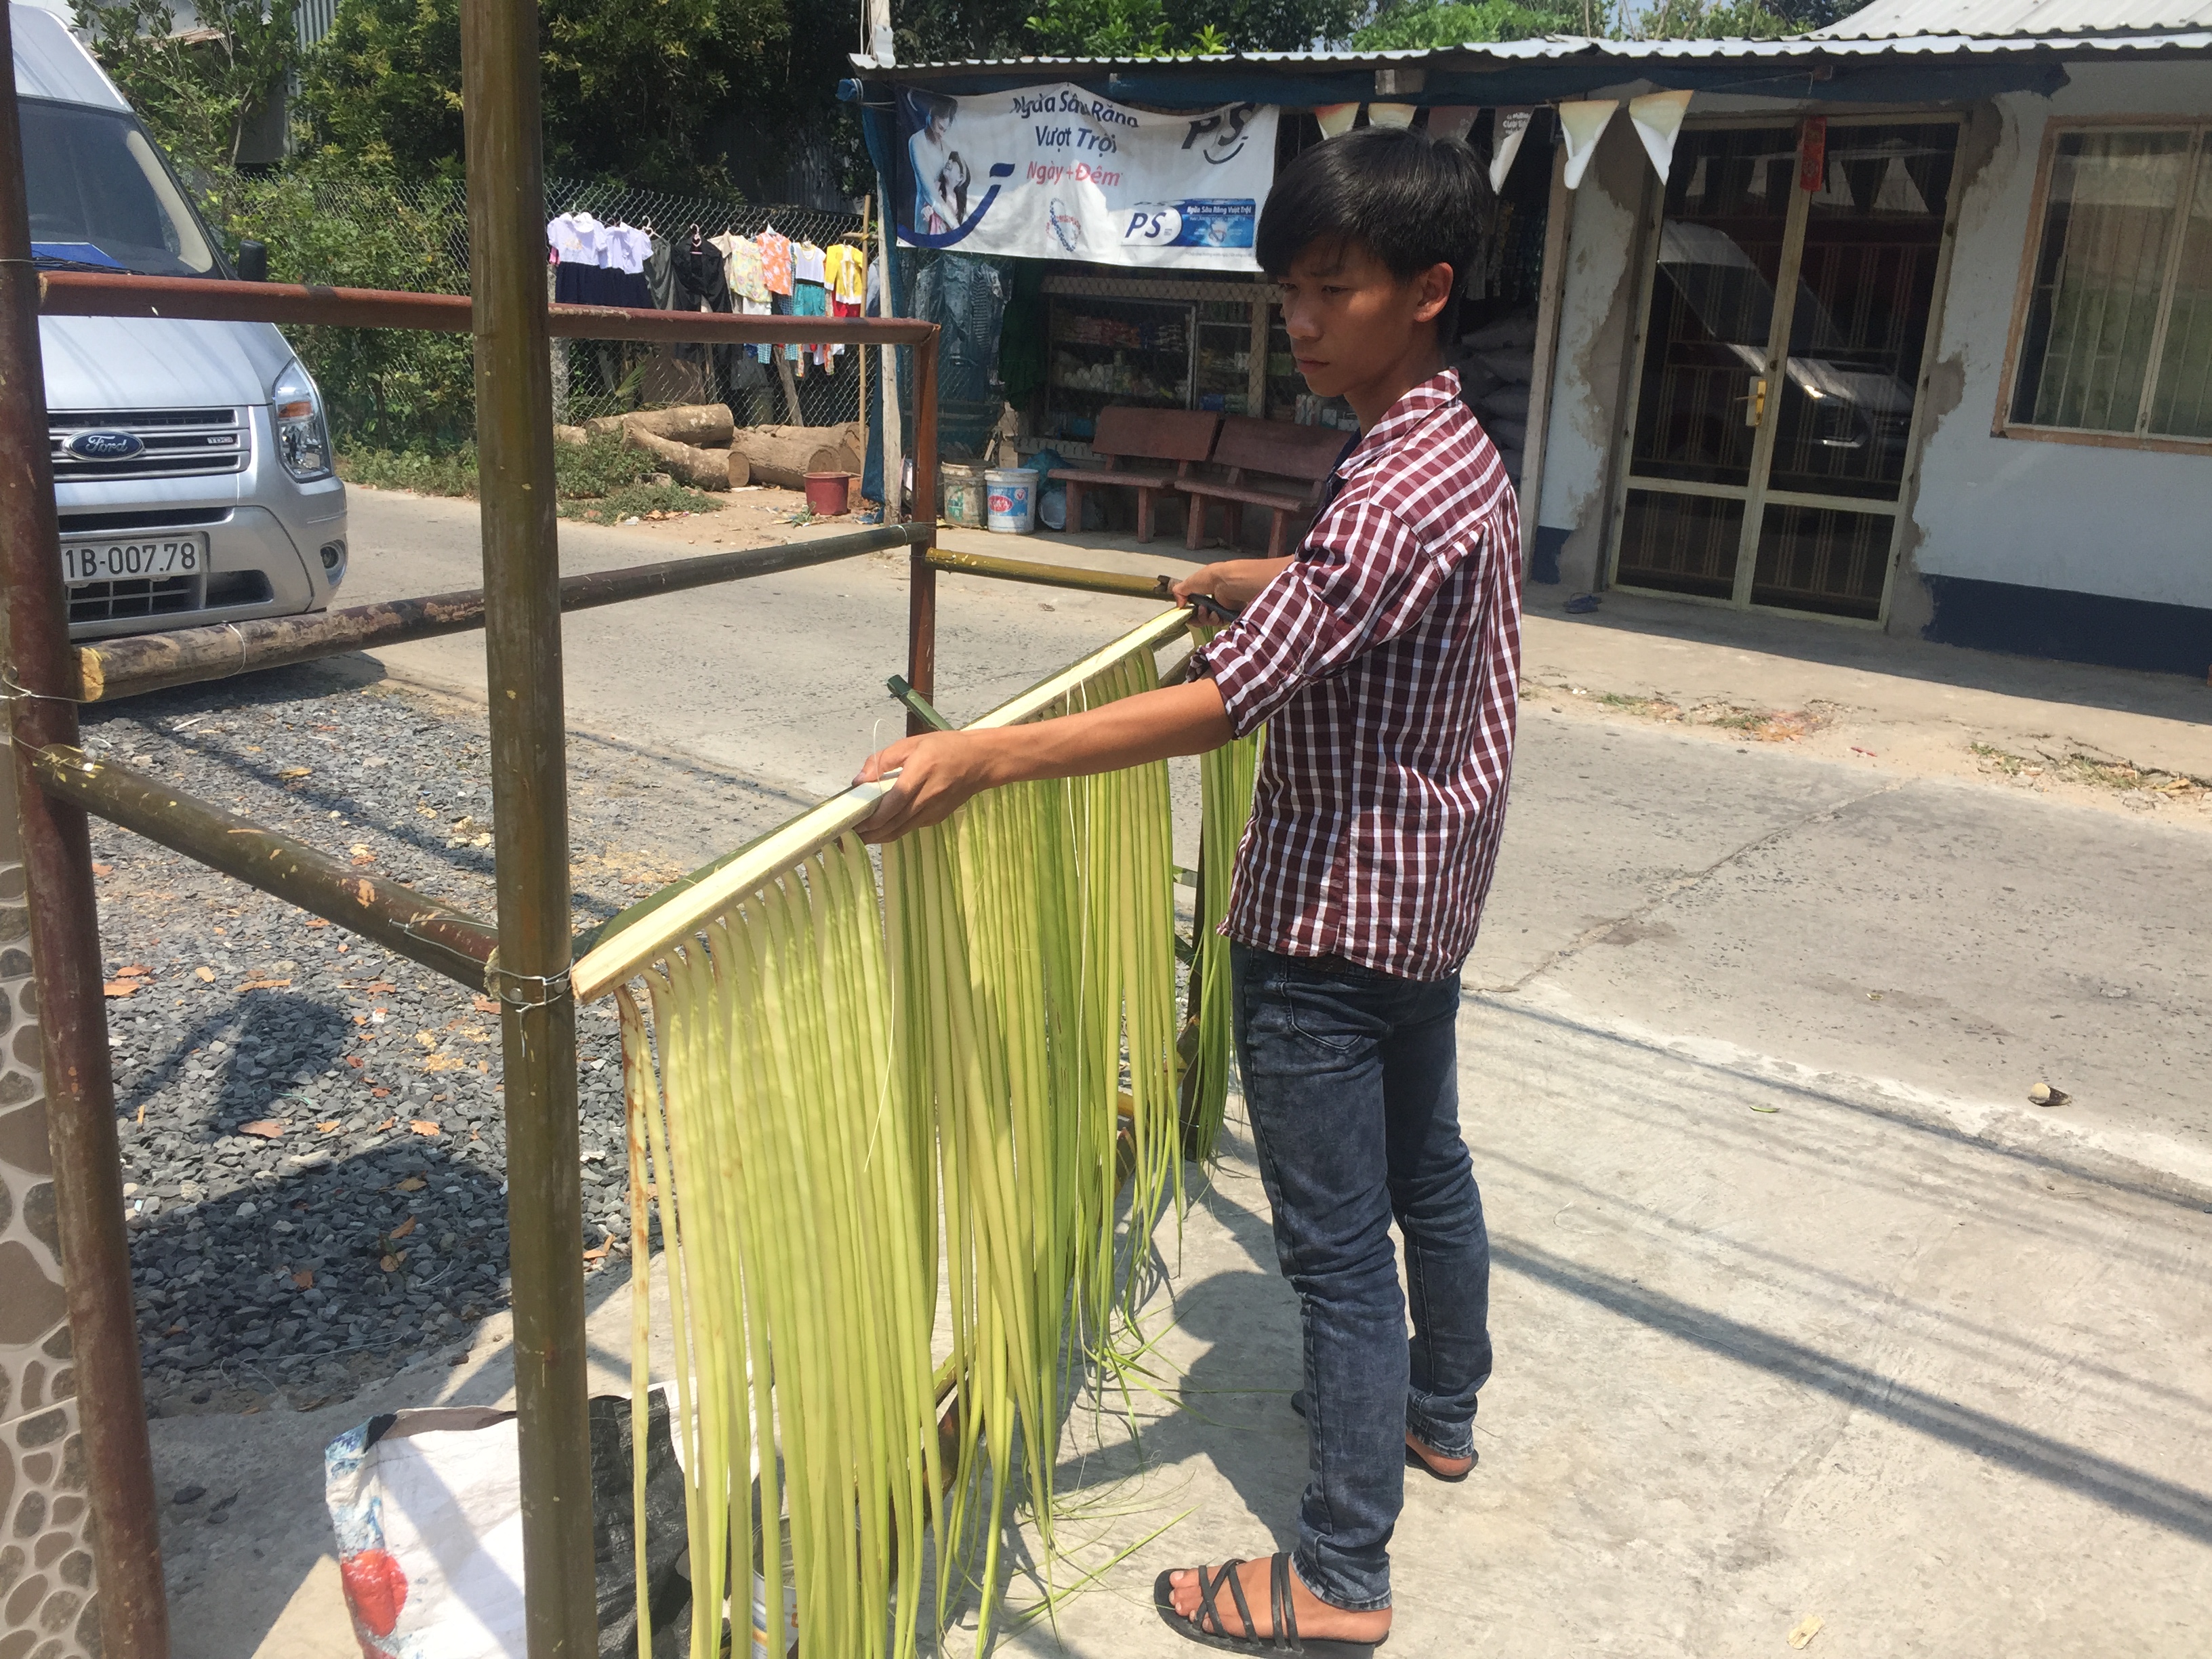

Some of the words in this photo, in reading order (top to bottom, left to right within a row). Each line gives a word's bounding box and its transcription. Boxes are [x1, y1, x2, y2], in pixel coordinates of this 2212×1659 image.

[1035, 125, 1072, 152] Vượt
[1076, 127, 1117, 157] Trội
[1026, 160, 1064, 185] Ngày
[1075, 162, 1120, 186] Đêm
[1124, 212, 1167, 239] PS
[85, 434, 129, 453] Ford
[65, 541, 196, 578] 1B-007.78
